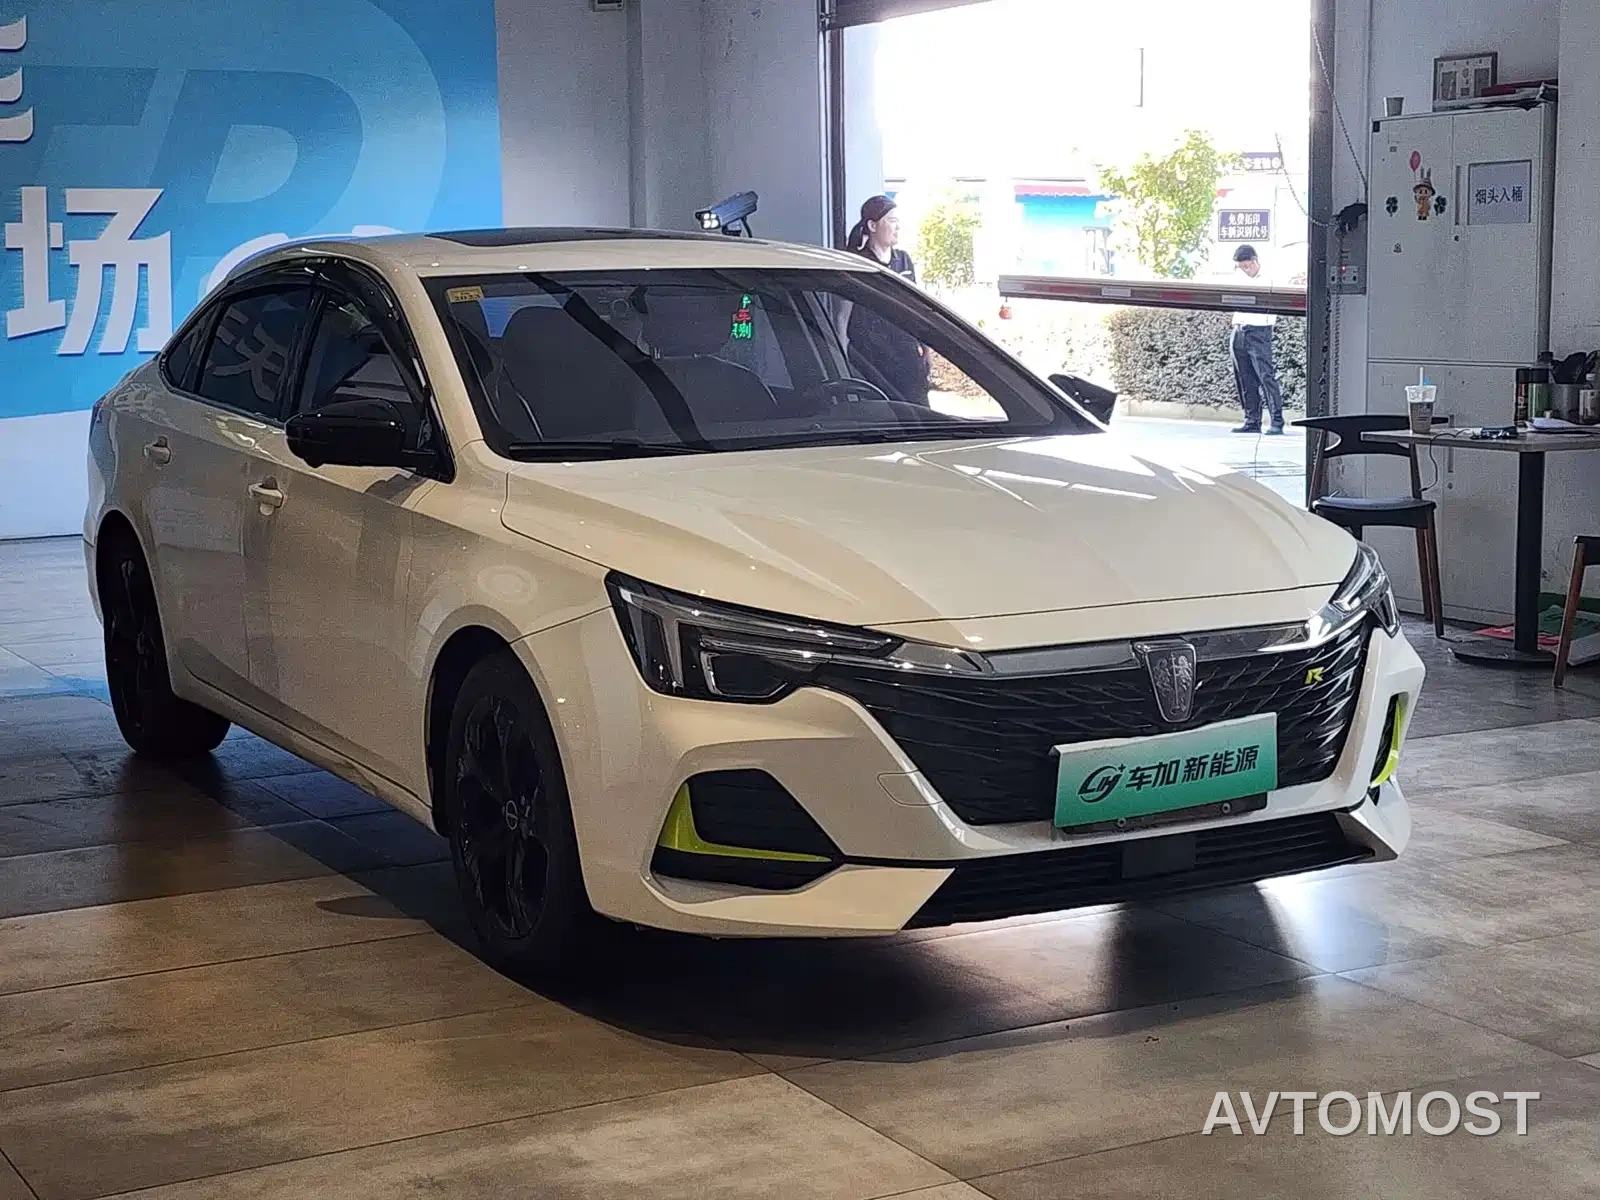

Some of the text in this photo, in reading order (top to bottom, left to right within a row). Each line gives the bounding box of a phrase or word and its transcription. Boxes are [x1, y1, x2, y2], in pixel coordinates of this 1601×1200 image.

[1475, 186, 1523, 205] 烟头入桶
[1228, 212, 1261, 226] 免费拓印
[1220, 226, 1267, 239] 车辆识别代号
[5, 186, 173, 355] 场
